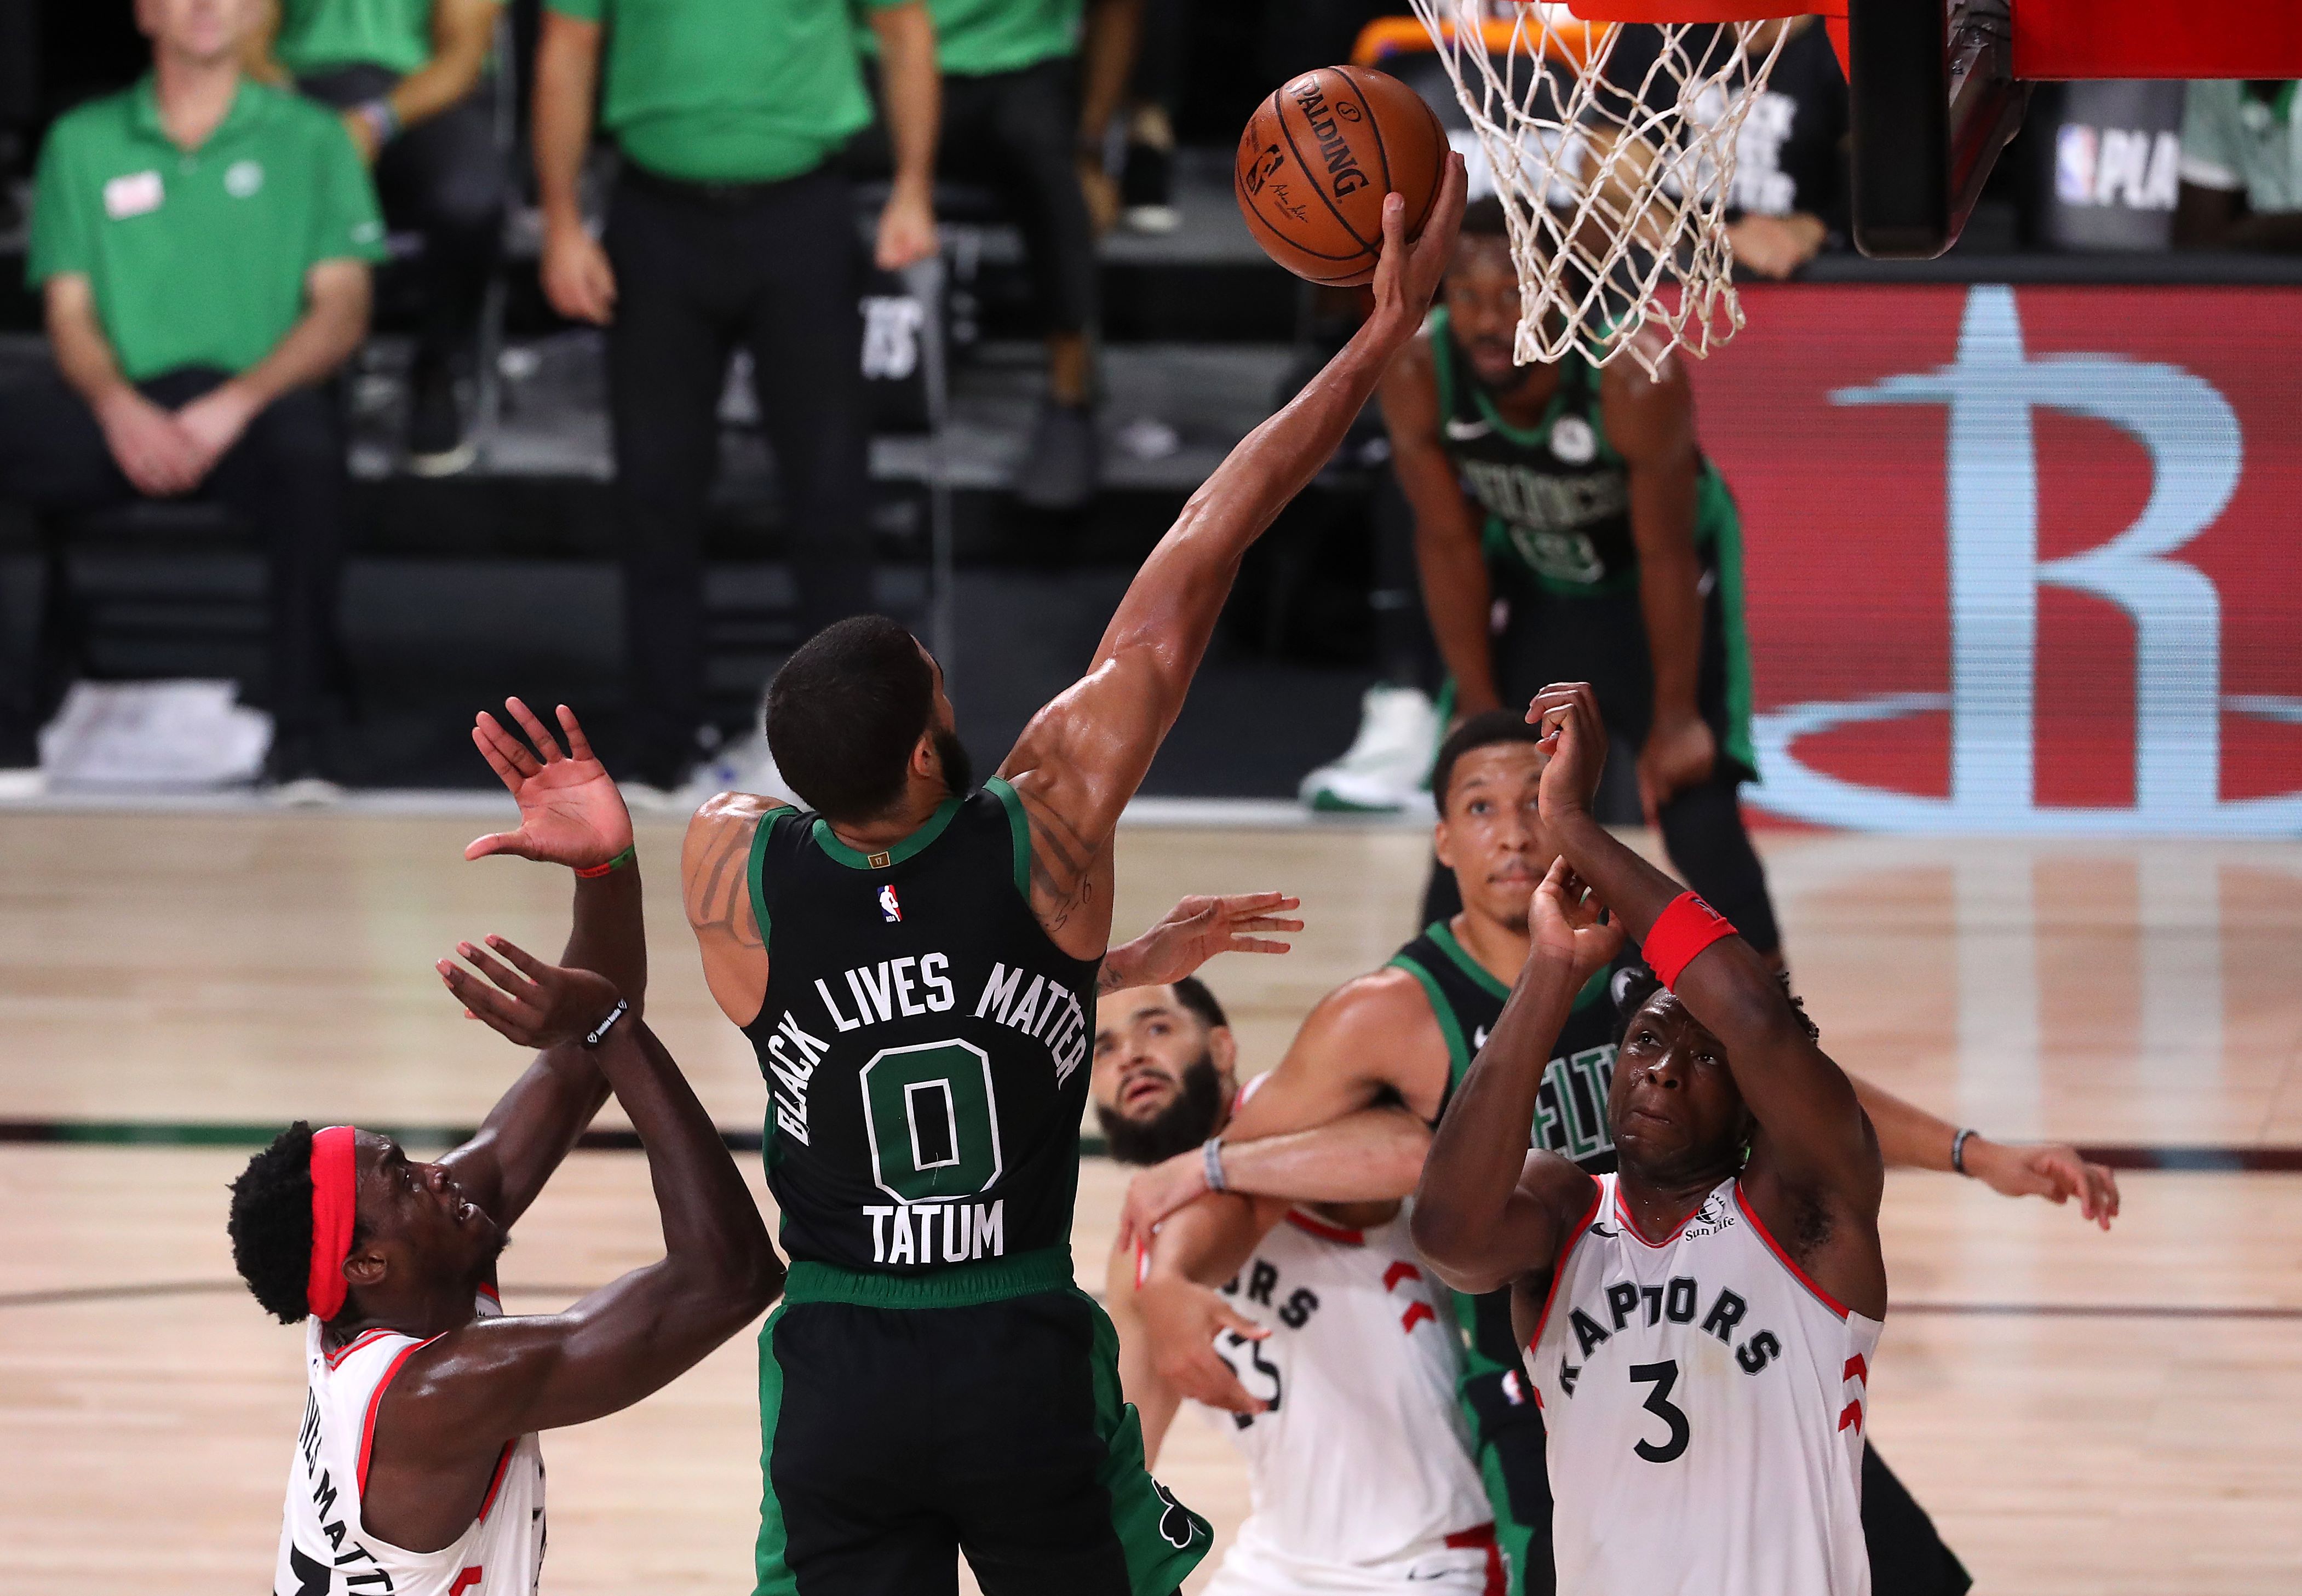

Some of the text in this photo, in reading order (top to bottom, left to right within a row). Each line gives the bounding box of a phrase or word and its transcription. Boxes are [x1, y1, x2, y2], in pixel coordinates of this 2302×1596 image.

[768, 952, 1087, 1147] BLACK LIVES MATTER
[859, 1038, 1003, 1206] 0
[863, 1199, 1004, 1265] TATUM
[1685, 1216, 1736, 1242] Sun Life
[1629, 1359, 1690, 1463] 3
[314, 1468, 394, 1596] MATT
